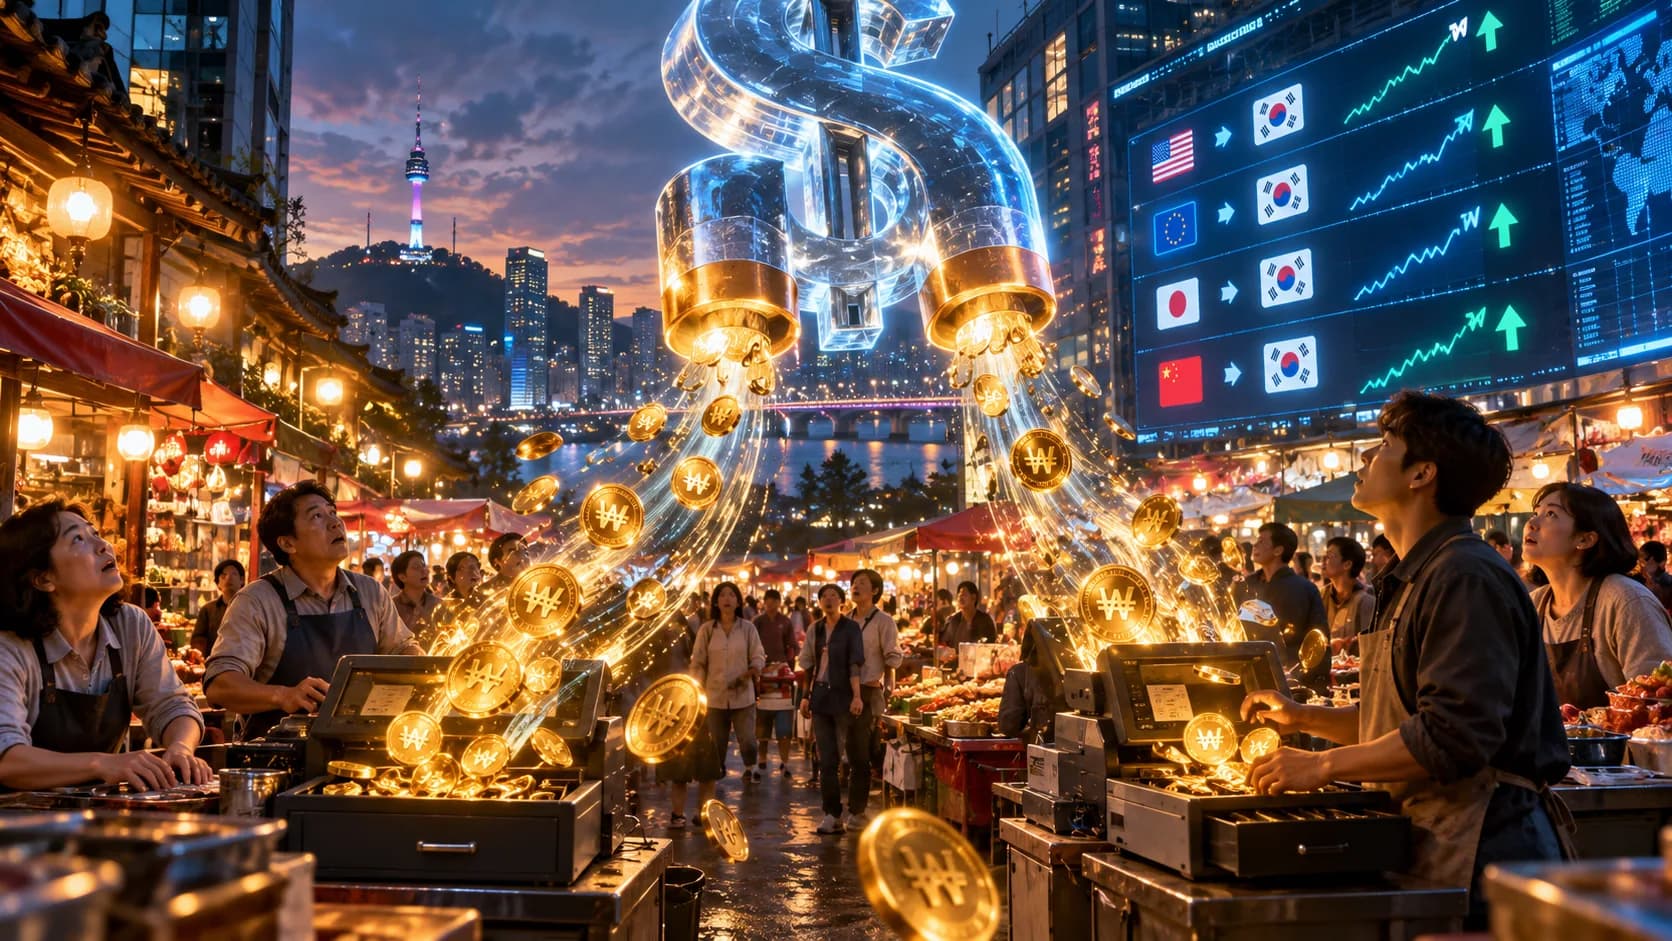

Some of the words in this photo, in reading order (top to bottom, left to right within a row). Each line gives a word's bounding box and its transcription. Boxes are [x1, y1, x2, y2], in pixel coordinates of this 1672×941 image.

[1024, 446, 1057, 474] ₩
[683, 471, 710, 495] ₩
[595, 500, 629, 532] ₩
[524, 582, 564, 618] ₩
[1096, 586, 1136, 620] ₩
[464, 659, 508, 694] ₩
[645, 694, 687, 736] ₩
[400, 725, 429, 751] ₩
[1196, 727, 1225, 750] ₩
[900, 846, 968, 907] ₩
